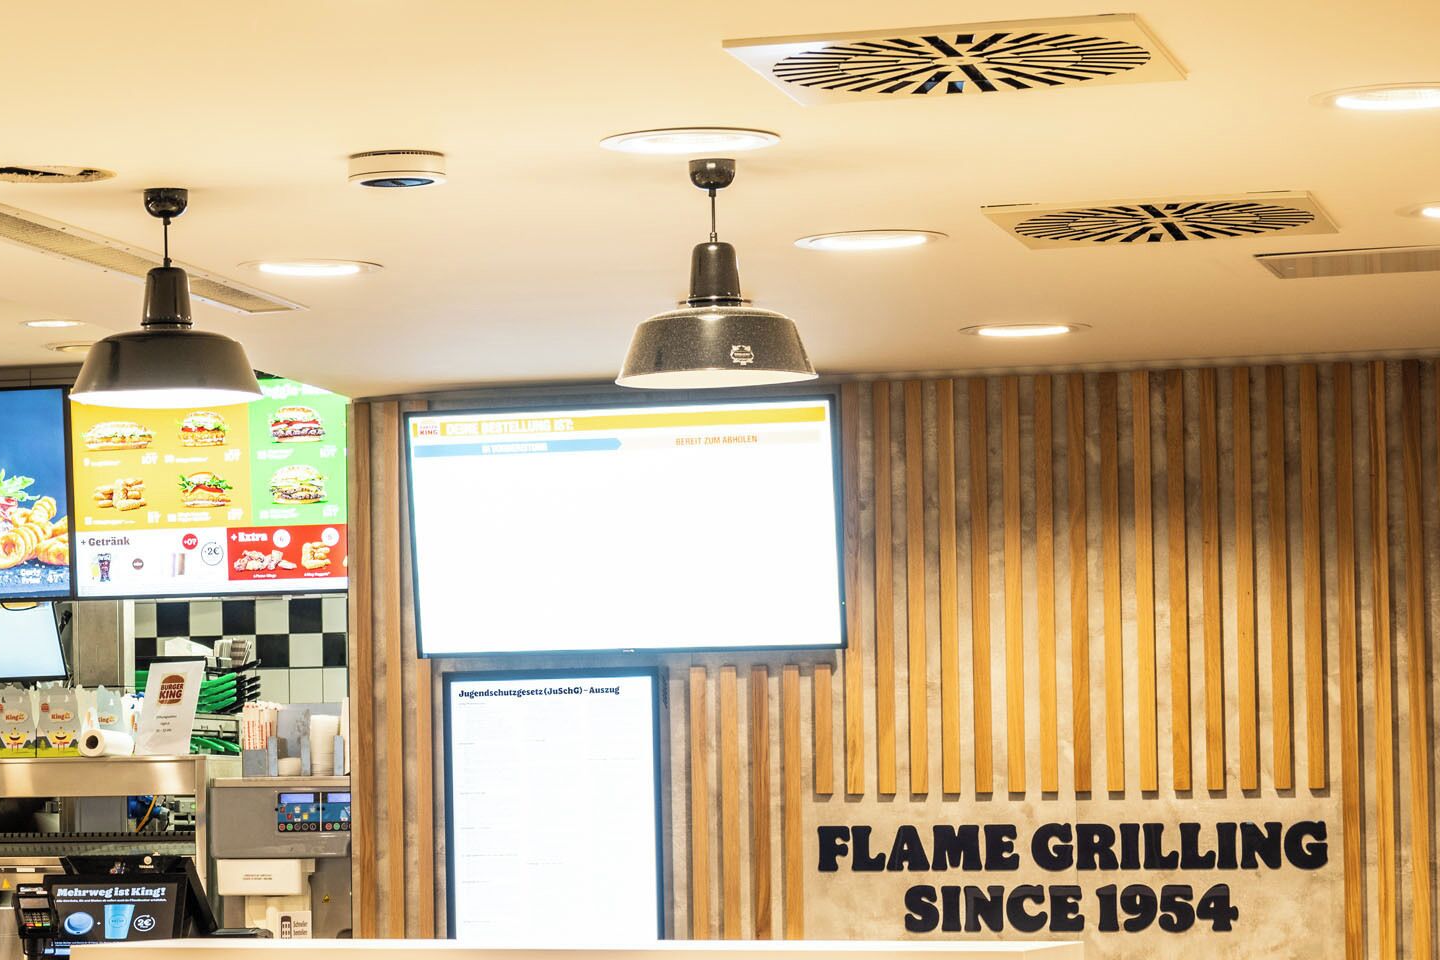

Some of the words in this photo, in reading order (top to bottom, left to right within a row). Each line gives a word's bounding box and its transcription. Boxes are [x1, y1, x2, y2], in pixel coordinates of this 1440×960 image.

[481, 419, 551, 435] BESTELLUNG
[675, 436, 702, 446] BEREIT
[704, 436, 721, 445] ZUM
[722, 434, 758, 444] ABHOLEN
[88, 536, 130, 547] Getränk
[160, 683, 184, 691] BURGER
[458, 687, 543, 699] Jugendschutzgesetz
[544, 686, 583, 696] (JuSchG)
[589, 685, 620, 696] Auszug
[159, 689, 183, 700] KING
[5, 714, 19, 722] King
[817, 823, 1020, 872] FLAME
[1030, 821, 1329, 871] GRILLING
[56, 887, 113, 898] Mehrweg
[114, 887, 130, 896] ist
[131, 887, 166, 898] King!
[904, 884, 1085, 933] SINCE
[1098, 883, 1239, 933] 1954
